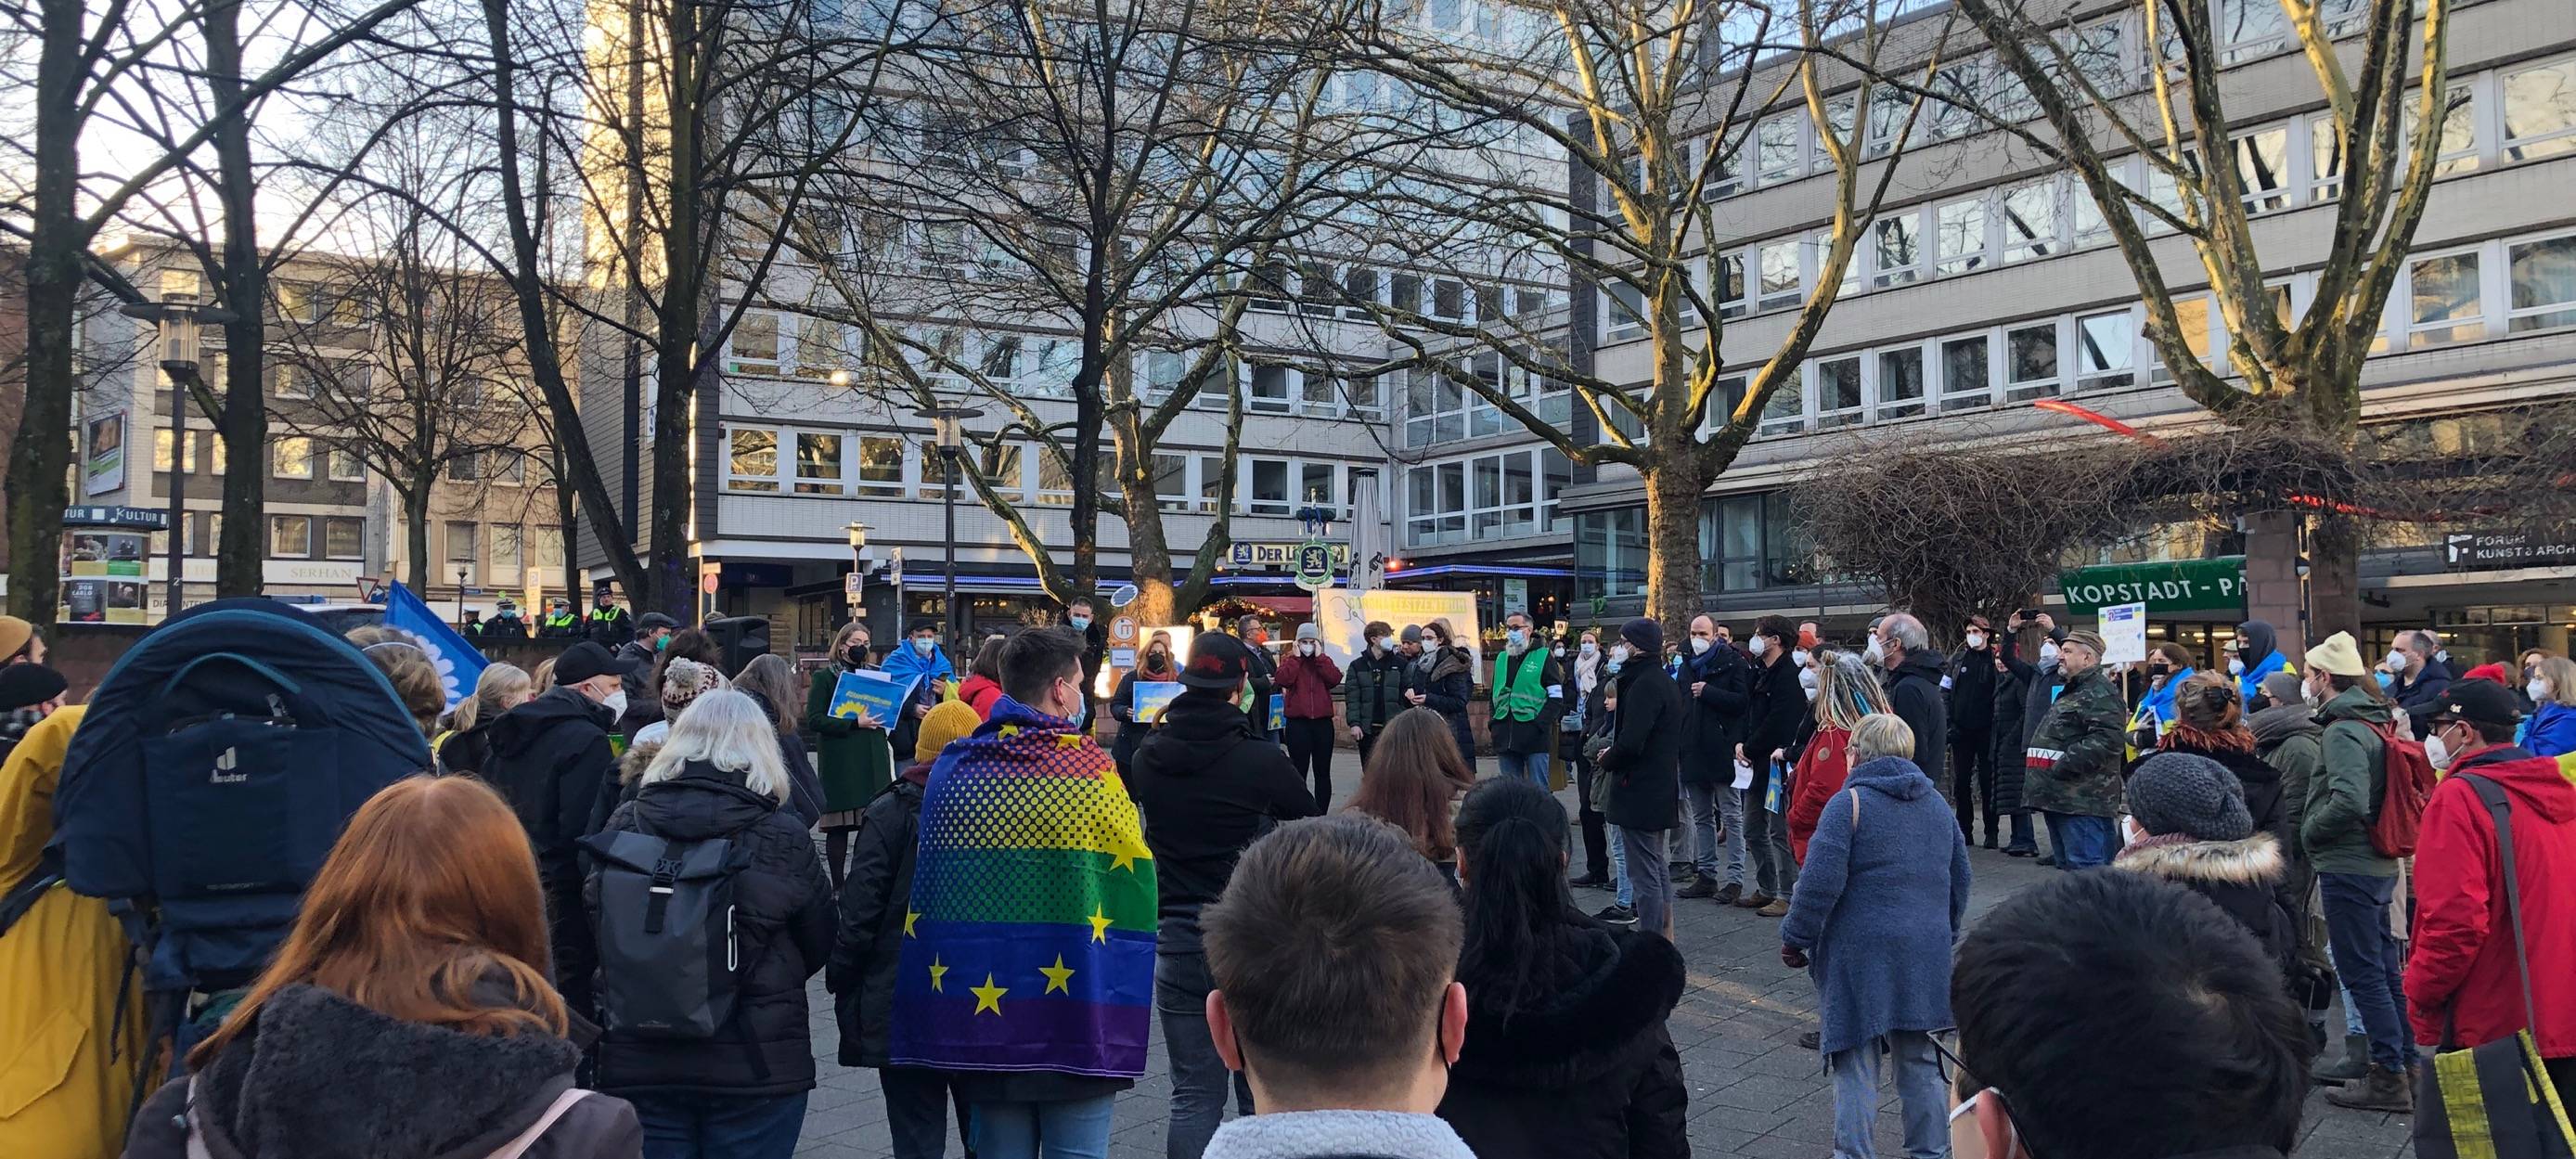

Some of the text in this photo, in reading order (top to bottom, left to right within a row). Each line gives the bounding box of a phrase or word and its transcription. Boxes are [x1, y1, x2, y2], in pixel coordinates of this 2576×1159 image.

[109, 507, 158, 523] KULTUR
[2476, 534, 2526, 547] FORUM
[1256, 545, 1282, 562] DER
[2476, 547, 2523, 560] KUNST
[290, 566, 354, 580] SERHAN
[2067, 579, 2194, 604] KOPSTADT
[210, 769, 248, 783] deuter
